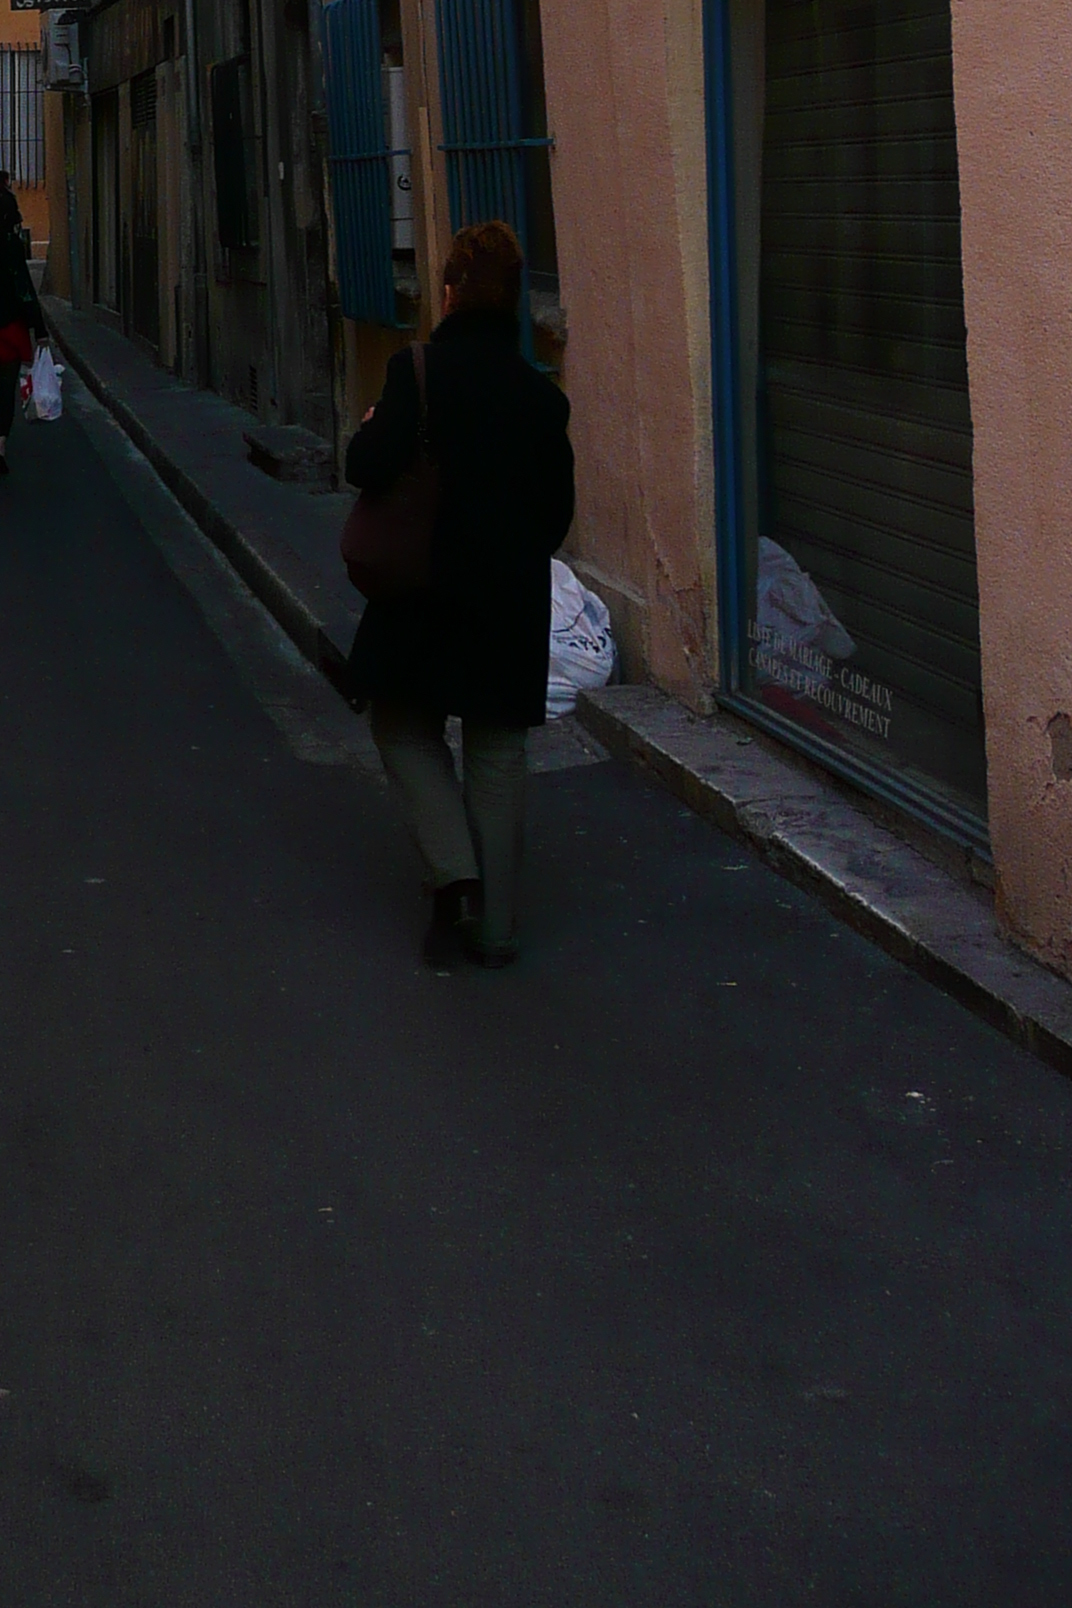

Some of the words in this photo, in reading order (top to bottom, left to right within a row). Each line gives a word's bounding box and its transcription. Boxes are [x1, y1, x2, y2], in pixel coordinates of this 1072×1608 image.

[747, 618, 772, 646] LISTE
[789, 635, 834, 681] MARIAGE
[840, 667, 894, 711] CADEAUX
[789, 668, 803, 691] ET
[804, 674, 891, 739] RECOUVREMENT
